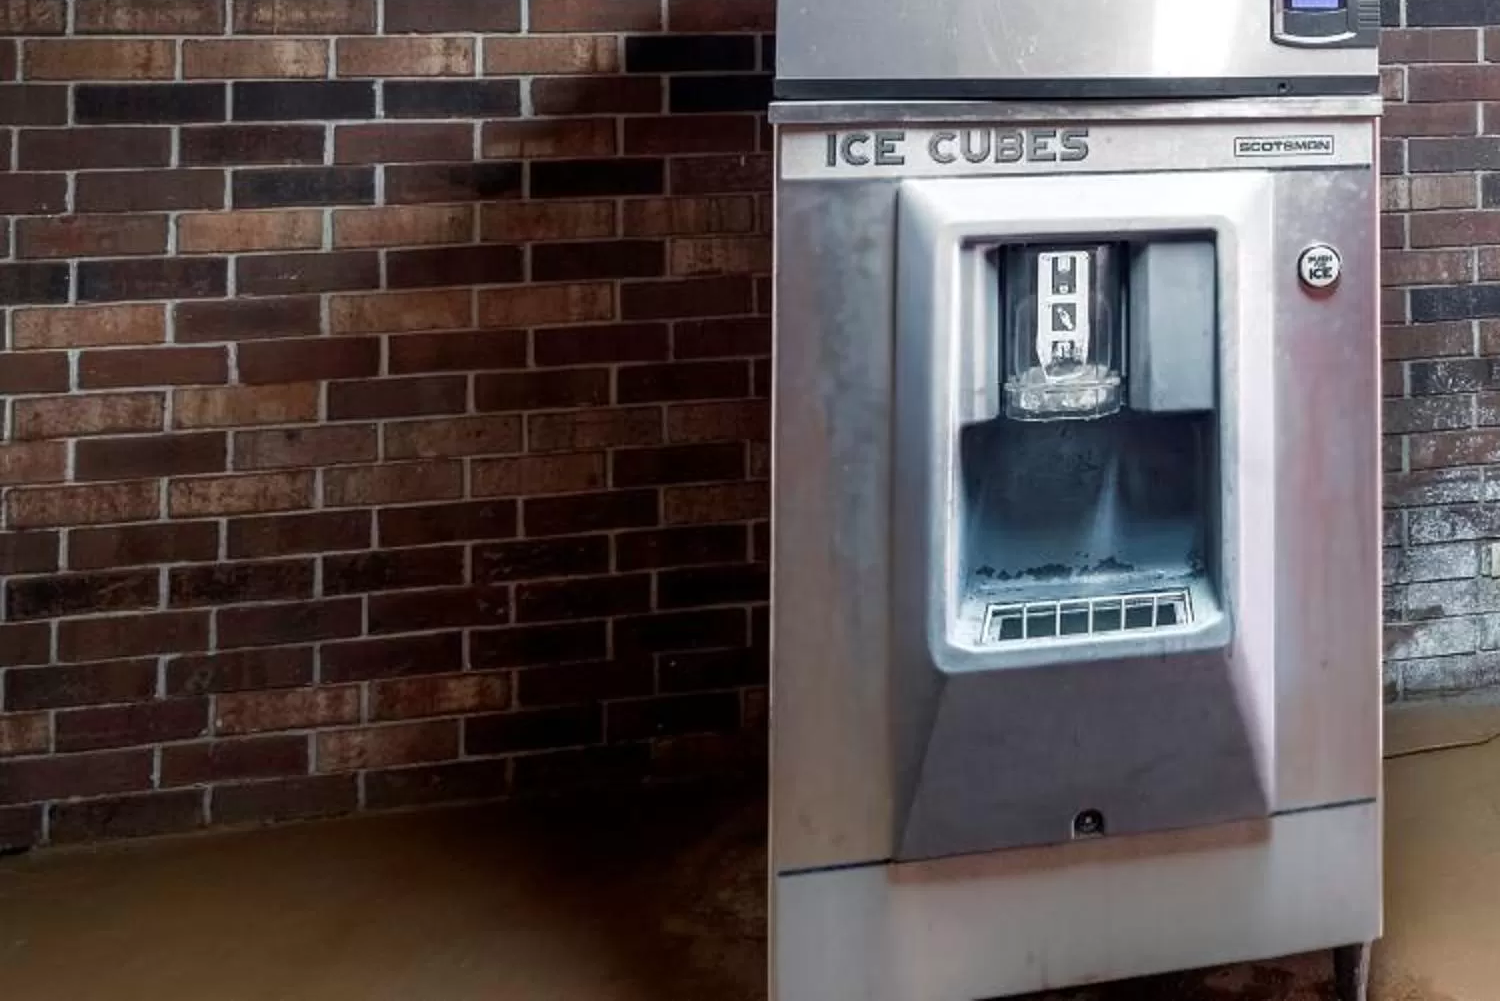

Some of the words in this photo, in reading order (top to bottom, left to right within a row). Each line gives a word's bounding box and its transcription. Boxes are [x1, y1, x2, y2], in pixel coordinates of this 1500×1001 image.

[825, 131, 905, 167] ICE
[928, 126, 1090, 163] CUBES
[1309, 267, 1333, 280] ICE
